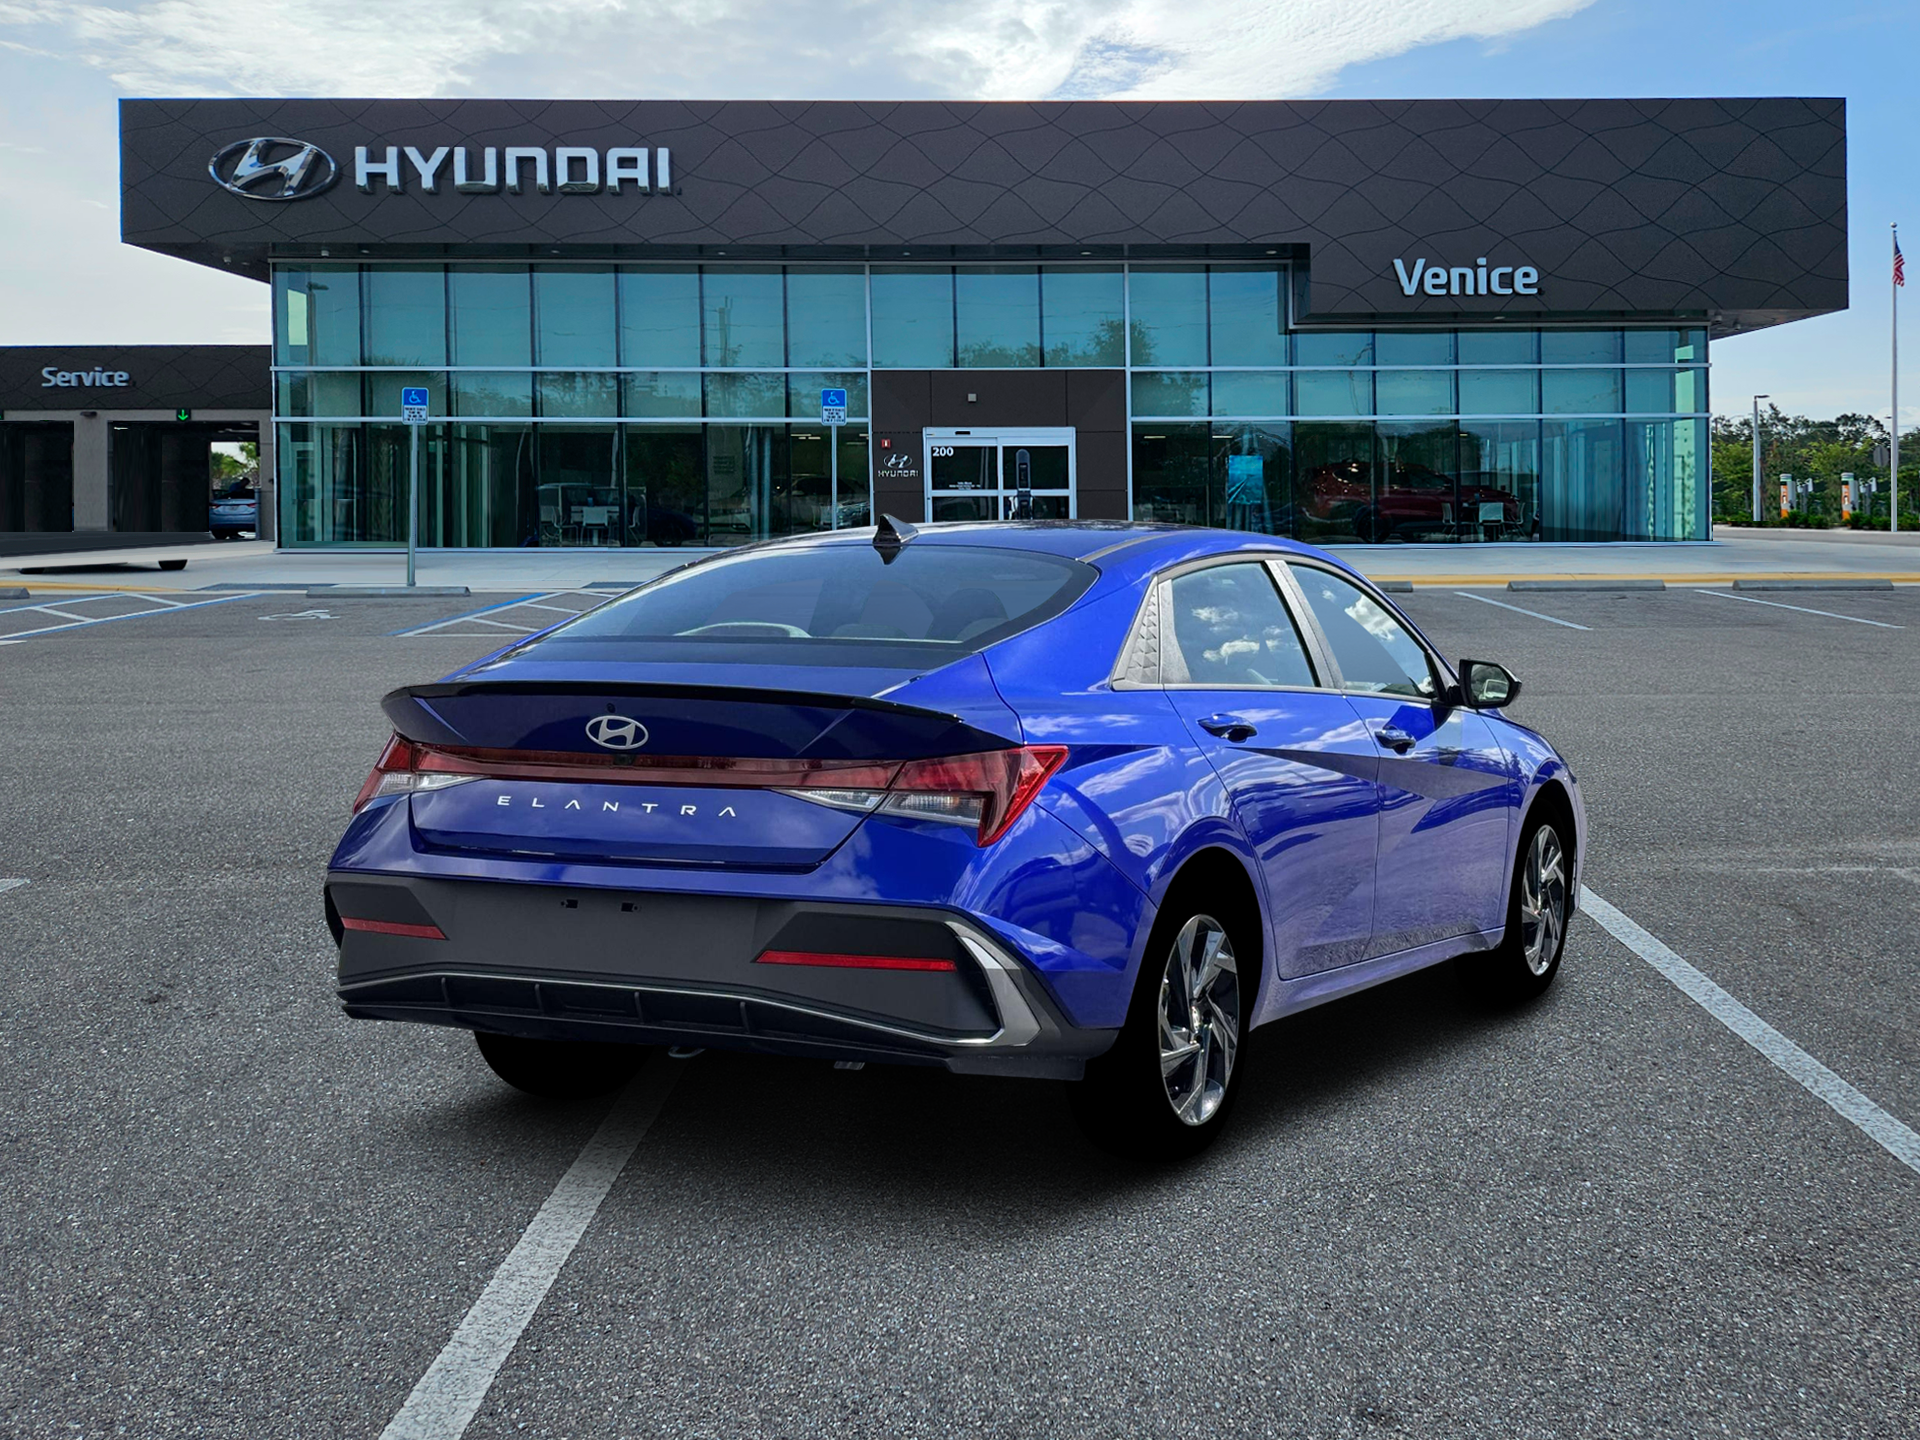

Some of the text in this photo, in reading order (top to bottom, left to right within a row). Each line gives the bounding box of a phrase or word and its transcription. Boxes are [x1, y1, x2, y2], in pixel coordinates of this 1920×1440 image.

[355, 146, 671, 194] HYUNDAI
[1393, 257, 1539, 297] Venice
[41, 366, 130, 388] Service
[932, 446, 955, 457] 200
[497, 795, 738, 818] ELANTRA
